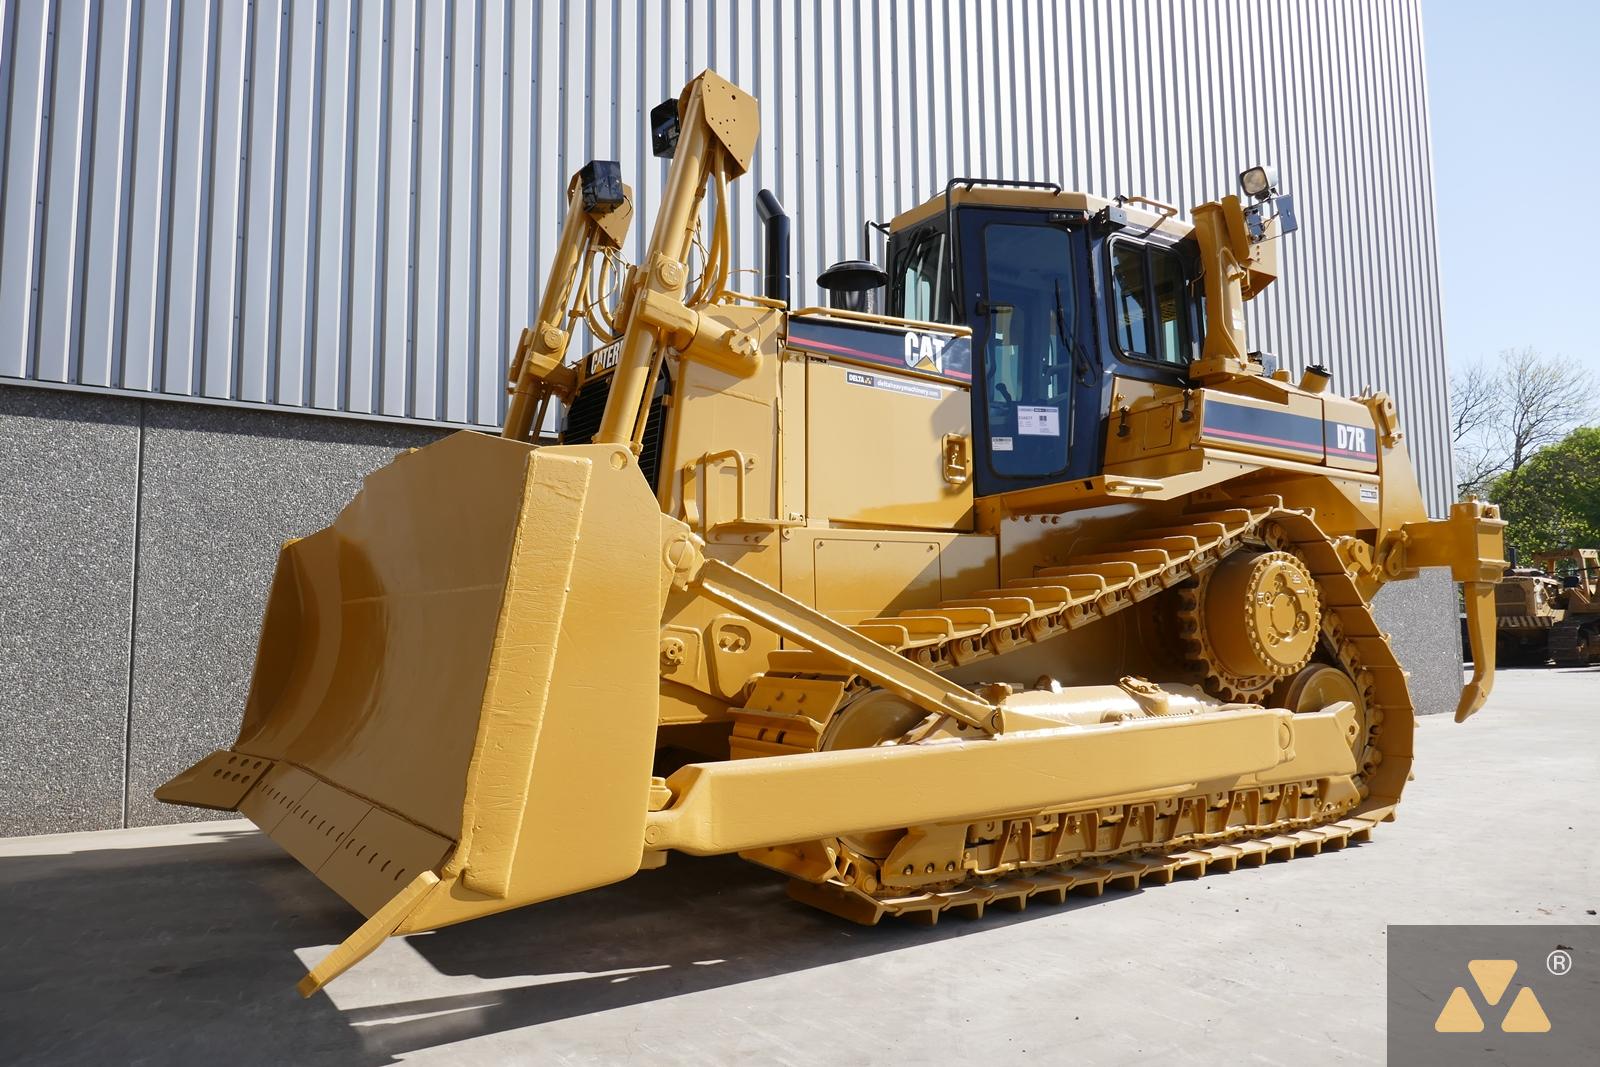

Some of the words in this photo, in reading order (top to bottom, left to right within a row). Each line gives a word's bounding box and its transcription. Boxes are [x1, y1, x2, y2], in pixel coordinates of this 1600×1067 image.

[591, 340, 624, 375] CATER
[905, 332, 945, 374] CAT
[848, 374, 865, 384] DELTA
[1337, 424, 1366, 453] D7R
